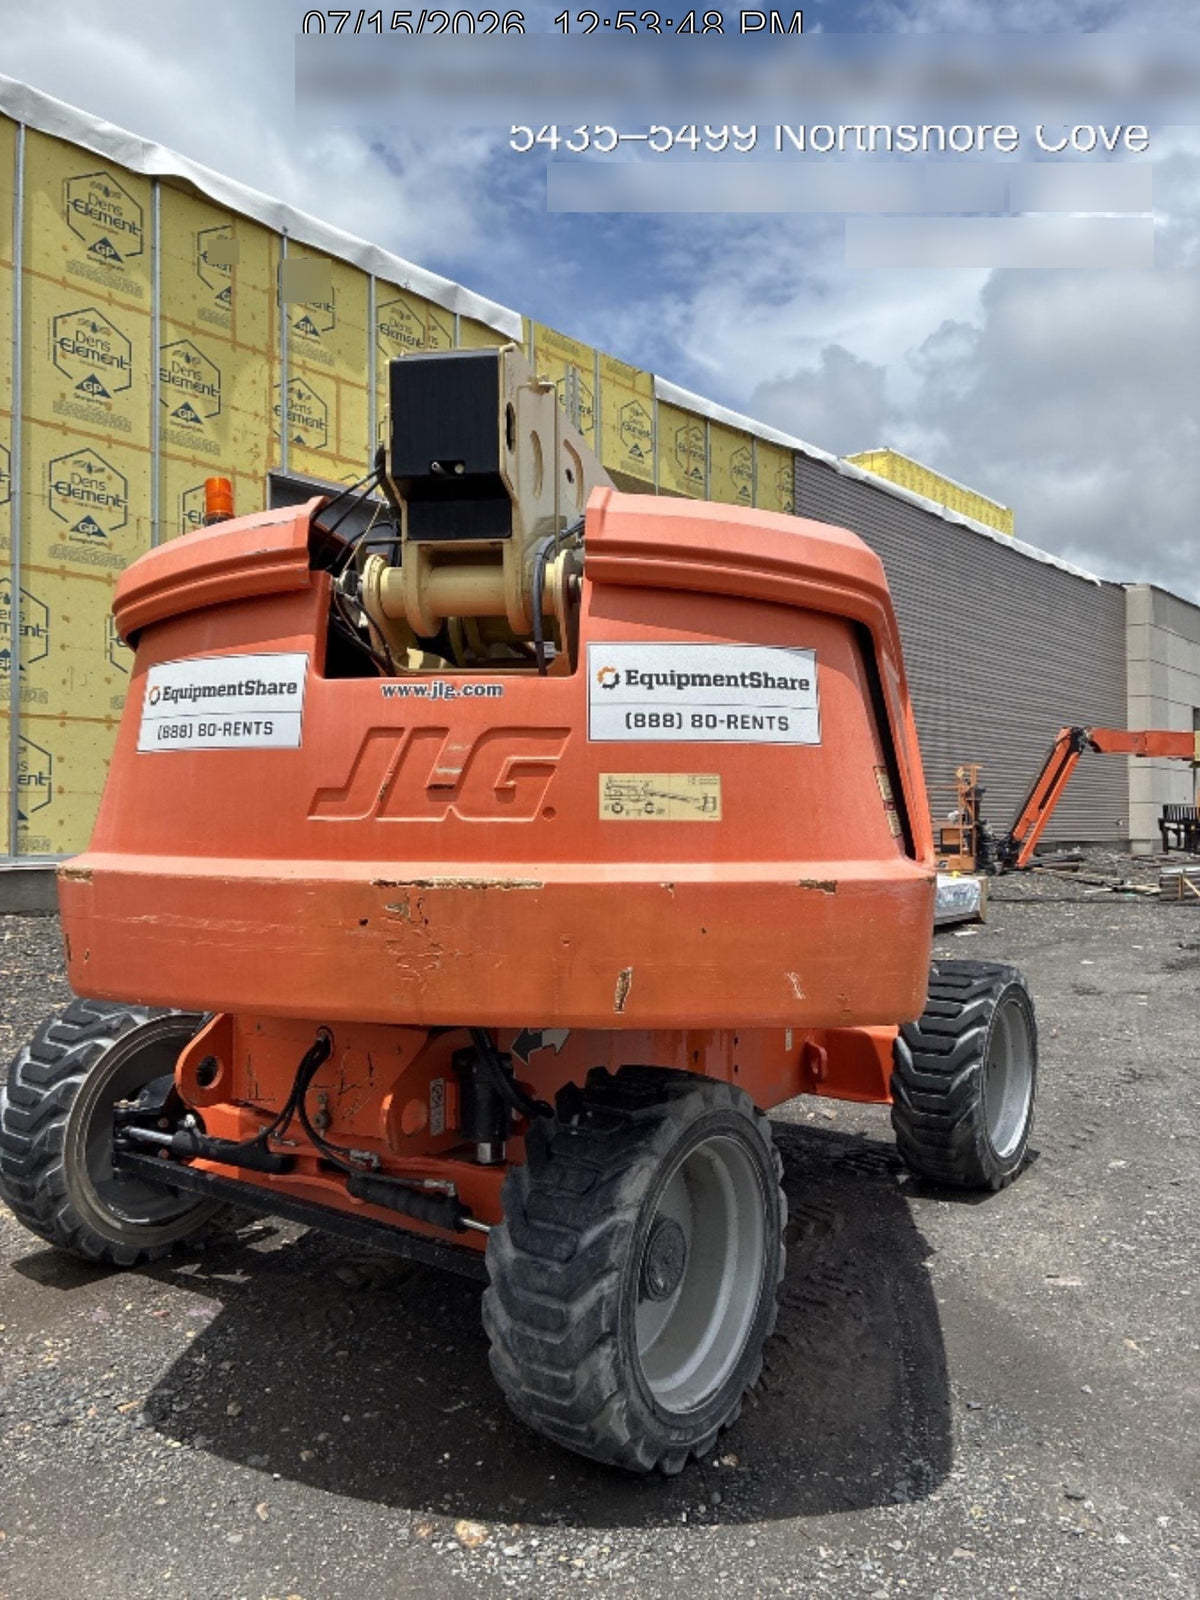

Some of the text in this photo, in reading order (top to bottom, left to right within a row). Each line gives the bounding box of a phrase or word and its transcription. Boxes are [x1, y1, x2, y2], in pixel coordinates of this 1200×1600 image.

[88, 192, 123, 216] Dens
[71, 199, 141, 237] Element
[94, 243, 115, 257] GP
[75, 330, 111, 352] Dens
[59, 337, 131, 370] Element
[159, 367, 220, 397] Element
[171, 361, 203, 381] Dens
[82, 381, 102, 396] GP
[179, 408, 196, 422] GP
[70, 472, 106, 491] Dens
[54, 481, 127, 508] Element
[77, 522, 98, 535] GP
[380, 681, 504, 701] www.jlg.com
[624, 669, 810, 691] EquipmentShare
[162, 680, 298, 704] EquipmentShare
[624, 712, 790, 731] (888) 80-RENTS
[307, 726, 571, 821] JLG
